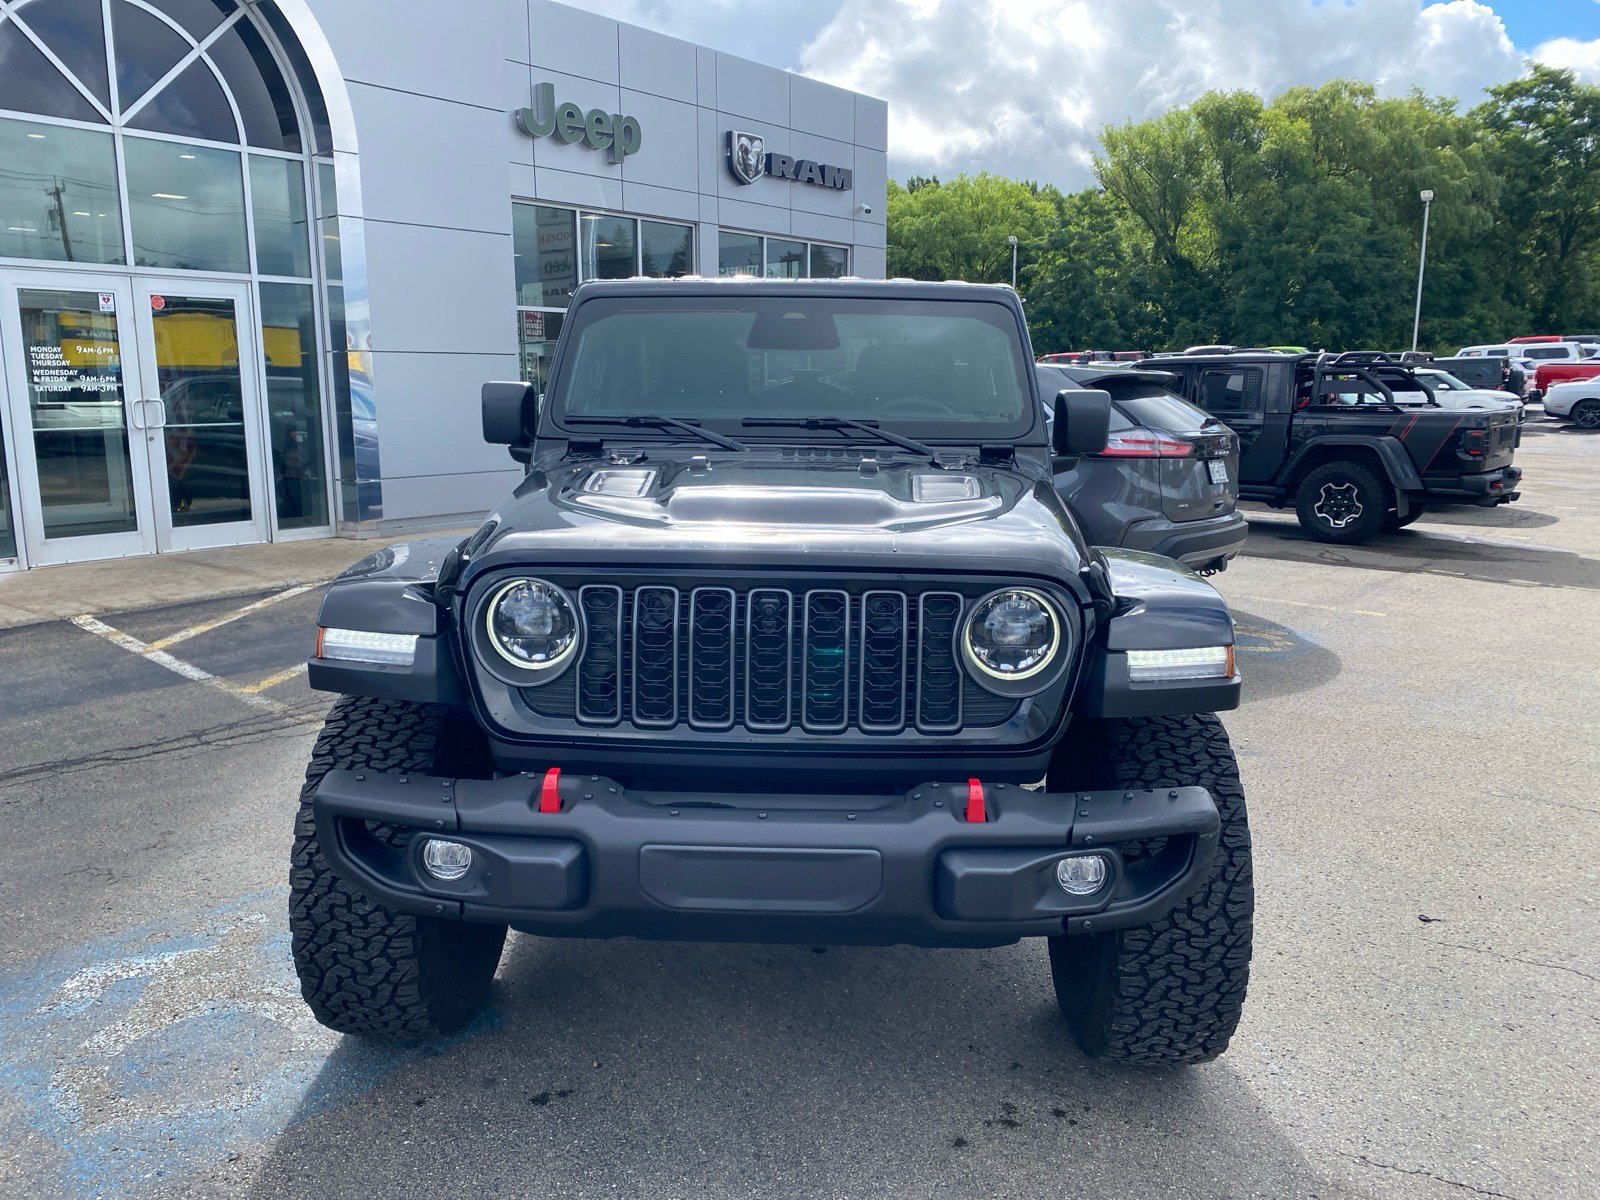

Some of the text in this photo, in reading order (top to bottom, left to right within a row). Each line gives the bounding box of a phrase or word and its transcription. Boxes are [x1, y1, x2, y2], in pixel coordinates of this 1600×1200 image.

[516, 82, 641, 164] Jeep
[766, 152, 852, 190] RAM
[76, 345, 114, 355] 9AM-6PM
[80, 375, 116, 383] 9AM-6PM
[80, 384, 117, 392] 9AM-3PM
